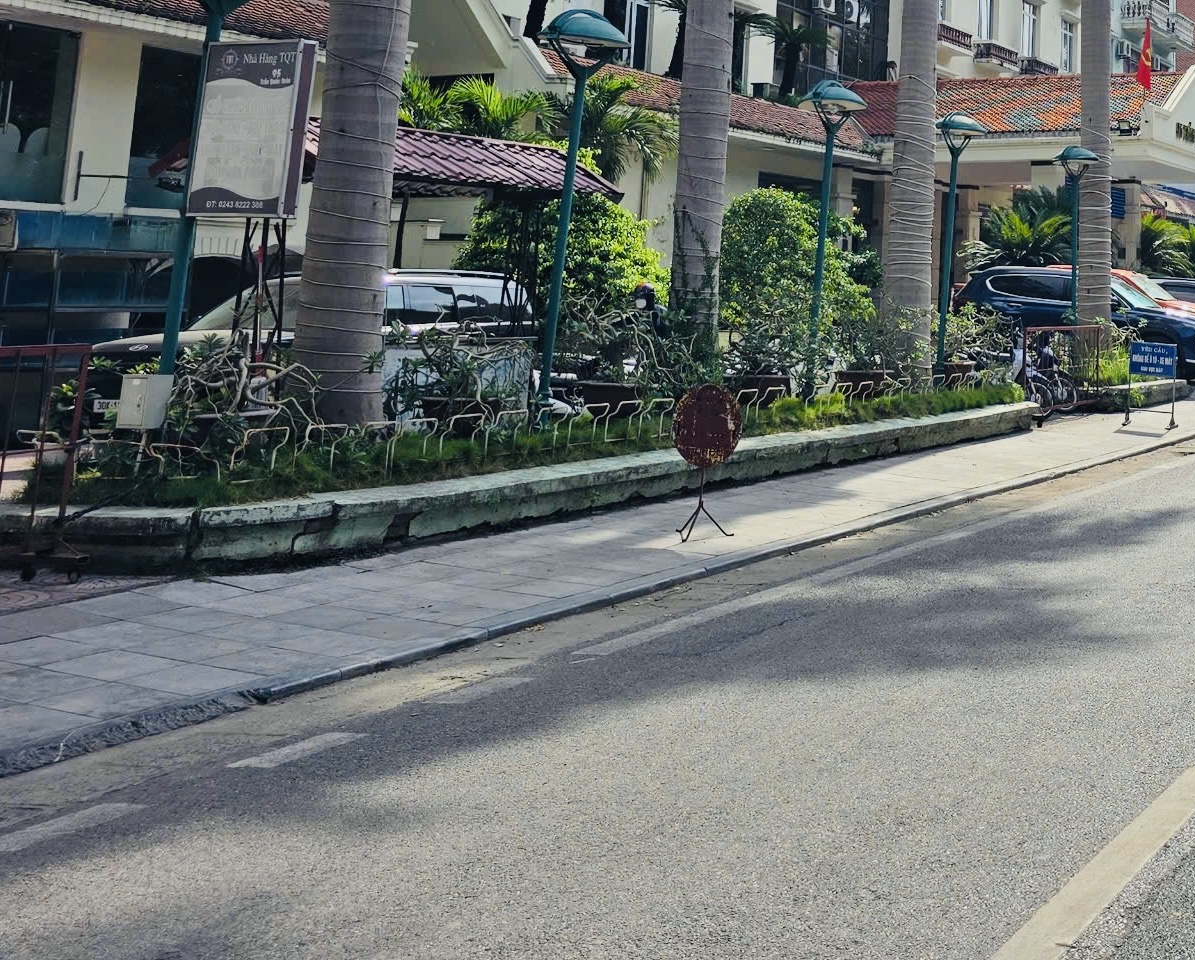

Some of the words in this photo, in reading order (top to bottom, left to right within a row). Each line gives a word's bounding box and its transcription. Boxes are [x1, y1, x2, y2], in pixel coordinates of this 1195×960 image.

[243, 53, 258, 64] Nhà
[259, 52, 278, 66] Hàng
[280, 51, 297, 64] TQT
[272, 68, 282, 78] 95
[218, 200, 234, 208] 0243
